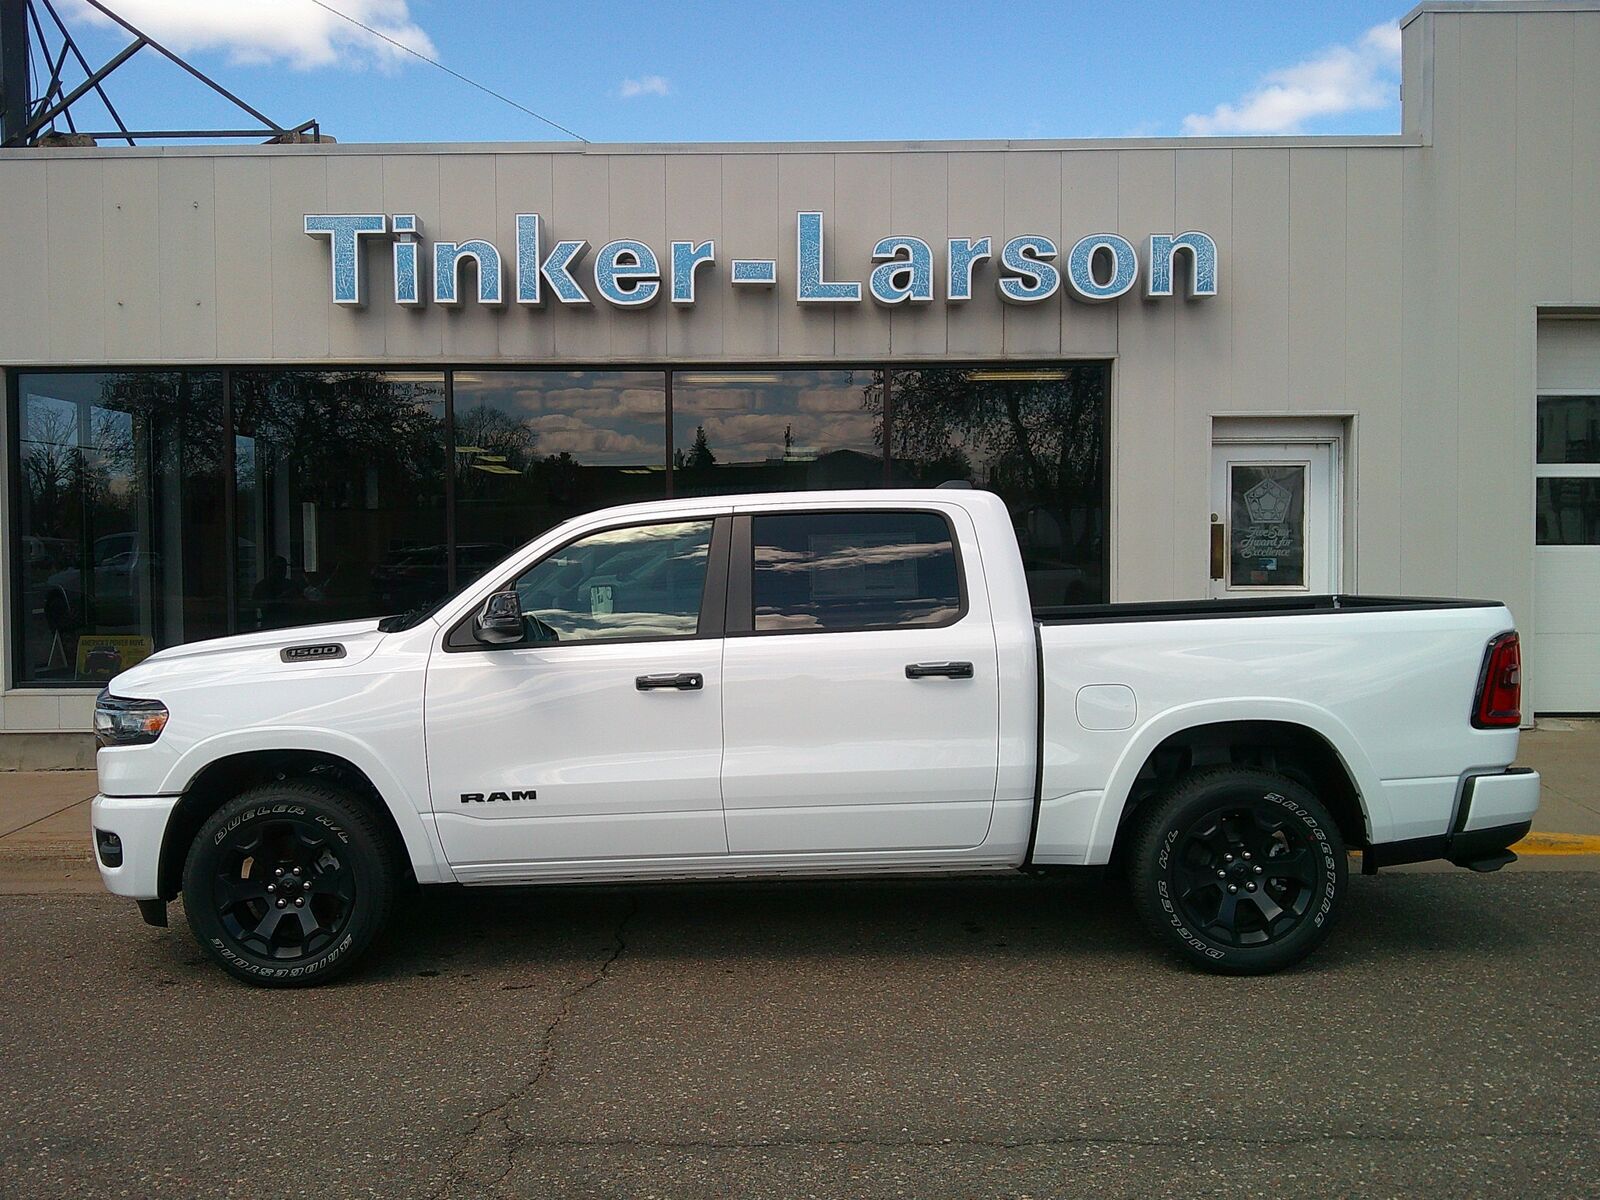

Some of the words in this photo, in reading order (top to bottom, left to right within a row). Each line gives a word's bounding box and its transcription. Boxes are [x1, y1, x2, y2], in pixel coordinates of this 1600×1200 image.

[303, 211, 1219, 305] Tinker-Larson
[1240, 537, 1279, 548] Award
[1275, 536, 1293, 549] for
[1246, 526, 1269, 538] Five
[1268, 525, 1291, 539] Star
[1240, 546, 1290, 559] Excellence
[286, 646, 338, 657] 1500
[460, 790, 537, 803] RAM
[214, 804, 306, 845] DUELER
[315, 815, 350, 844] H/L
[1159, 829, 1179, 869] H/L
[1264, 792, 1336, 928] BRIDGESTONE
[1158, 880, 1225, 960] DUELER
[210, 933, 353, 977] BRIDGESTONE
